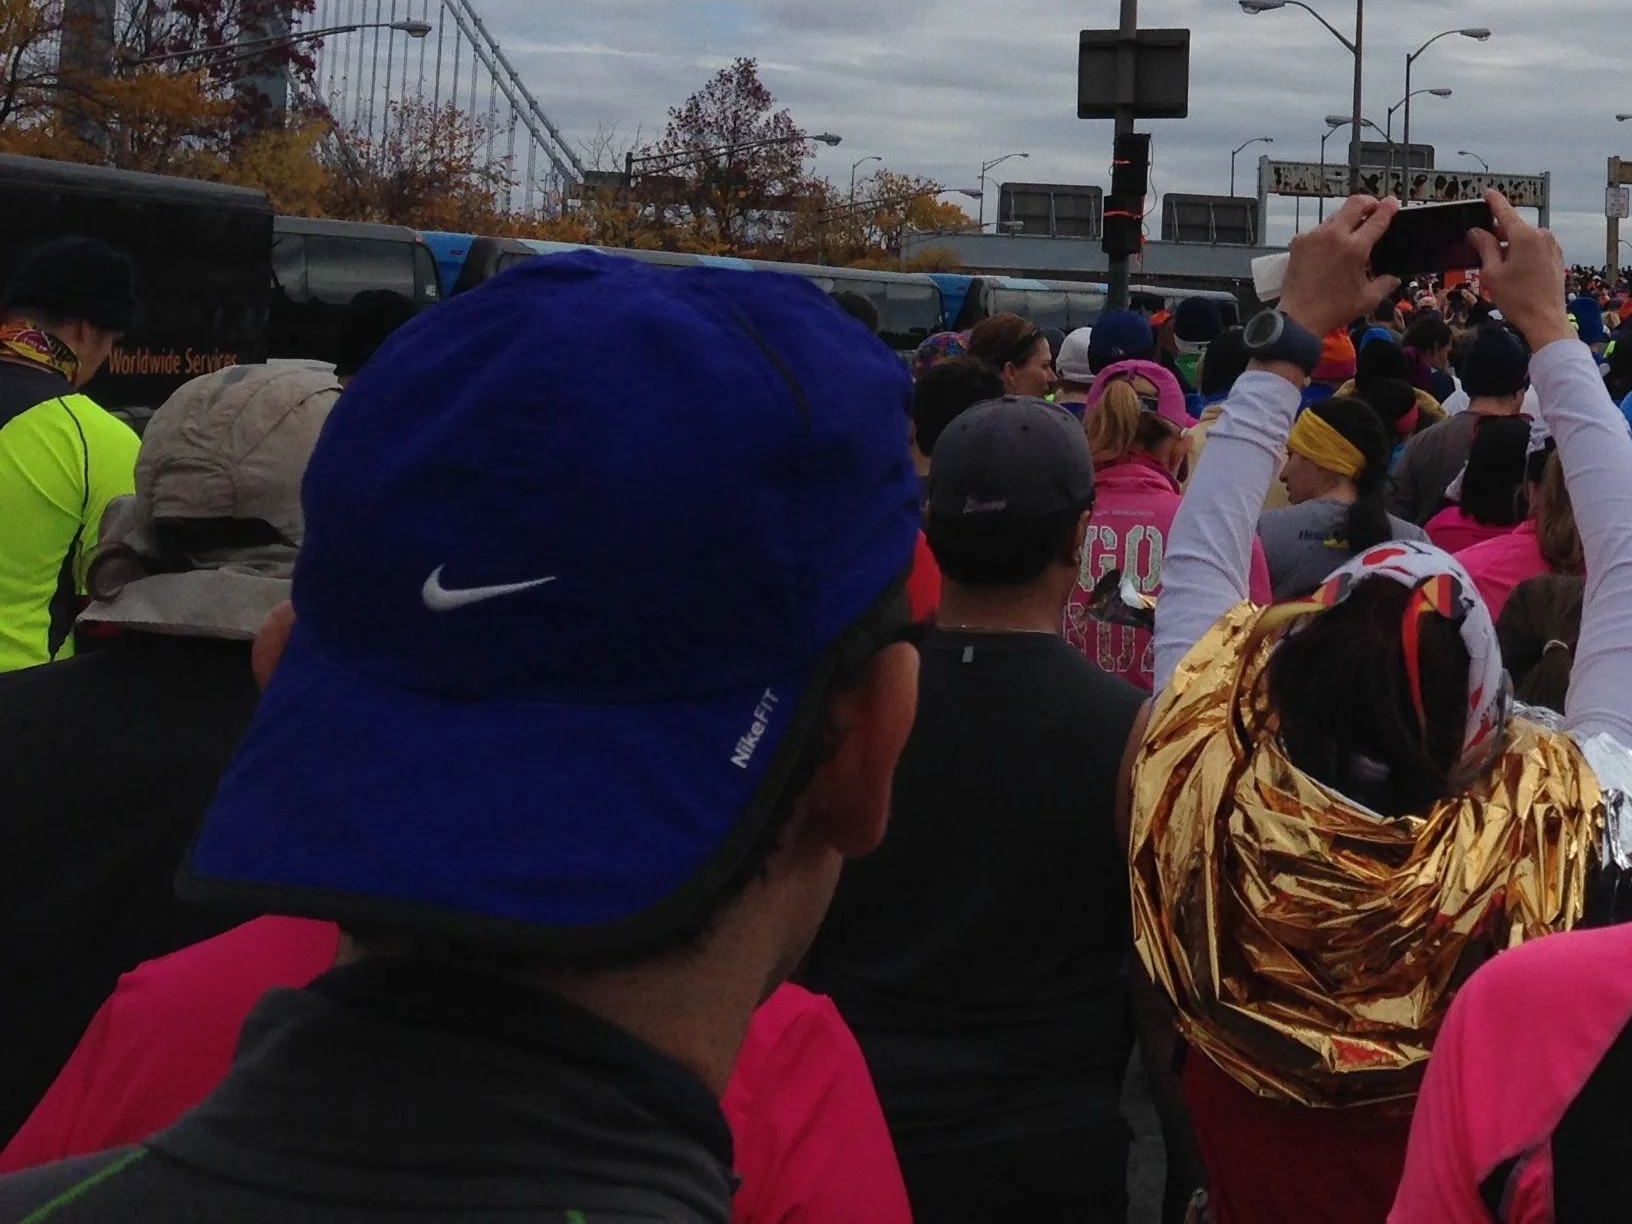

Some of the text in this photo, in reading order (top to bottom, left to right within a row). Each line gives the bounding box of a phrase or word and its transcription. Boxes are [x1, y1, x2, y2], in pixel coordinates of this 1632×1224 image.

[108, 347, 181, 374] Worldwide
[1078, 525, 1163, 592] GO
[730, 687, 779, 769] NikeFIT
